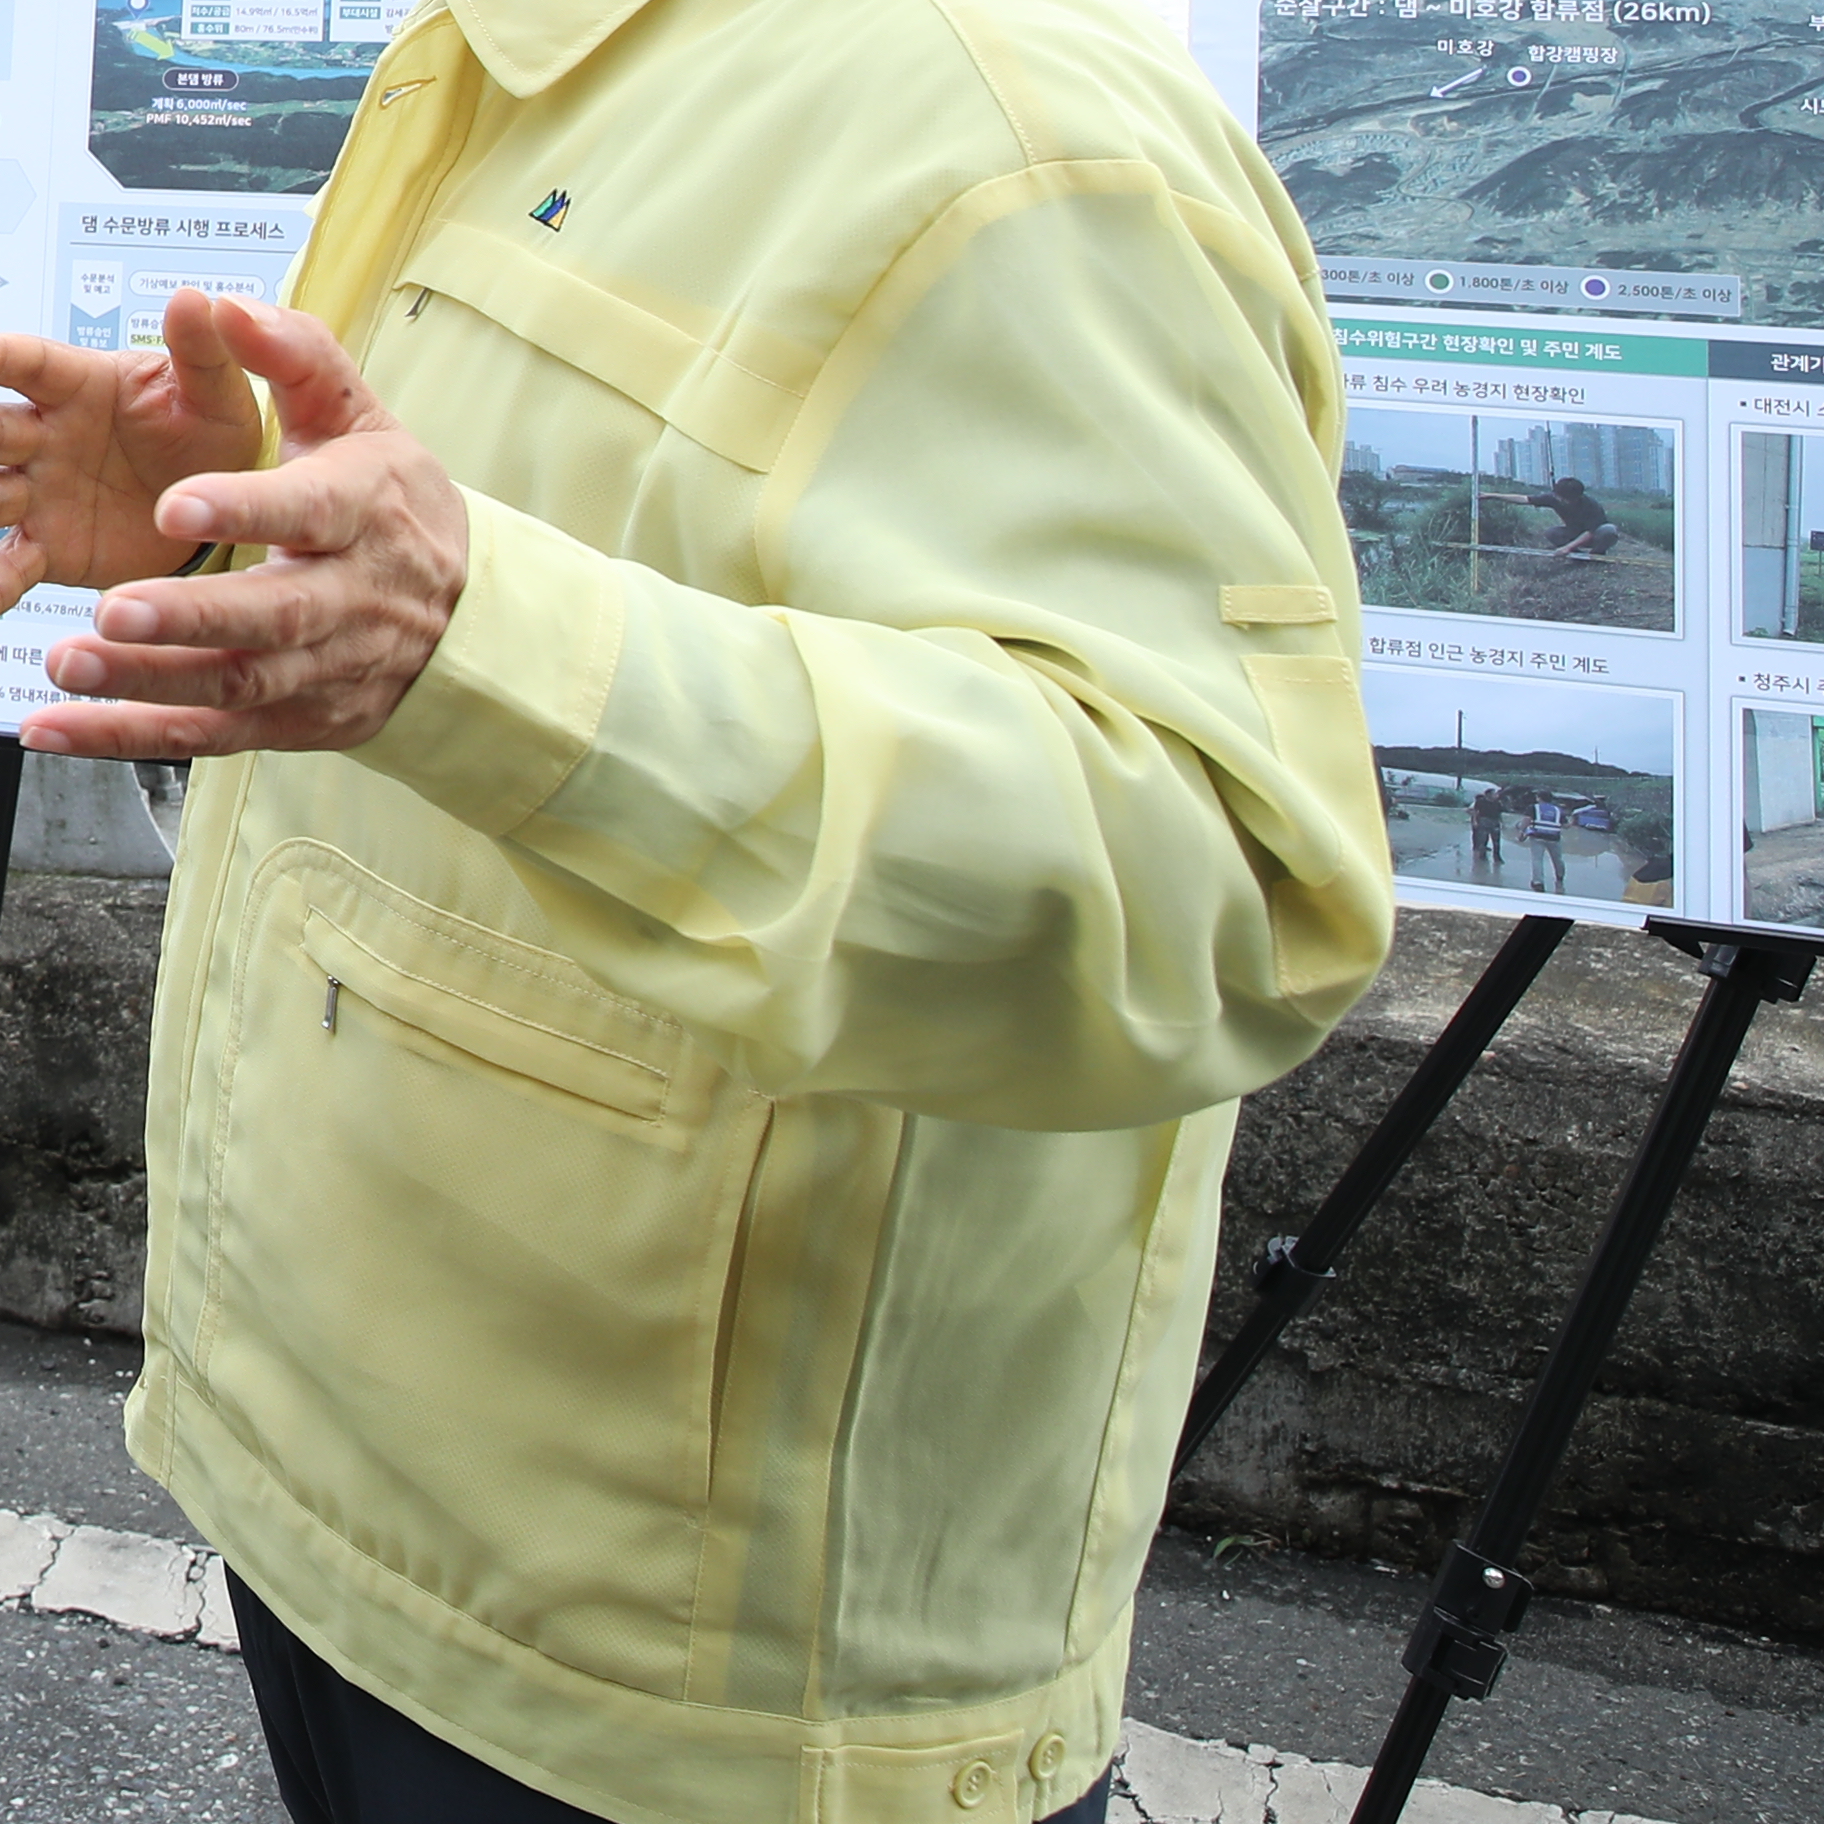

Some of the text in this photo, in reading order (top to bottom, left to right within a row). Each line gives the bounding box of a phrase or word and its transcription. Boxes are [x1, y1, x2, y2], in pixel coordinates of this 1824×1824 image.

[1613, 0, 1711, 25] (26km)
[1436, 38, 1494, 58] 미호강
[1528, 44, 1618, 66] 합강캠핑장
[202, 73, 224, 86] 방류
[152, 97, 174, 110] 계획
[146, 113, 171, 124] PMF
[82, 215, 285, 240] 댐 수문방류 시행 프로세스
[1387, 272, 1414, 286] 이상
[1536, 278, 1569, 295] 이상
[1702, 287, 1732, 304] 이상
[1332, 328, 1622, 362] 침수위험구간 현장확인 및 주민 계도
[1372, 375, 1585, 406] 침수 우려 농경지 현장확인
[1754, 397, 1811, 418] 대전시
[12, 648, 44, 666] 따른
[1369, 636, 1610, 675] 합류점 인근 농경지 주민 계도
[1754, 673, 1810, 696] 청주시
